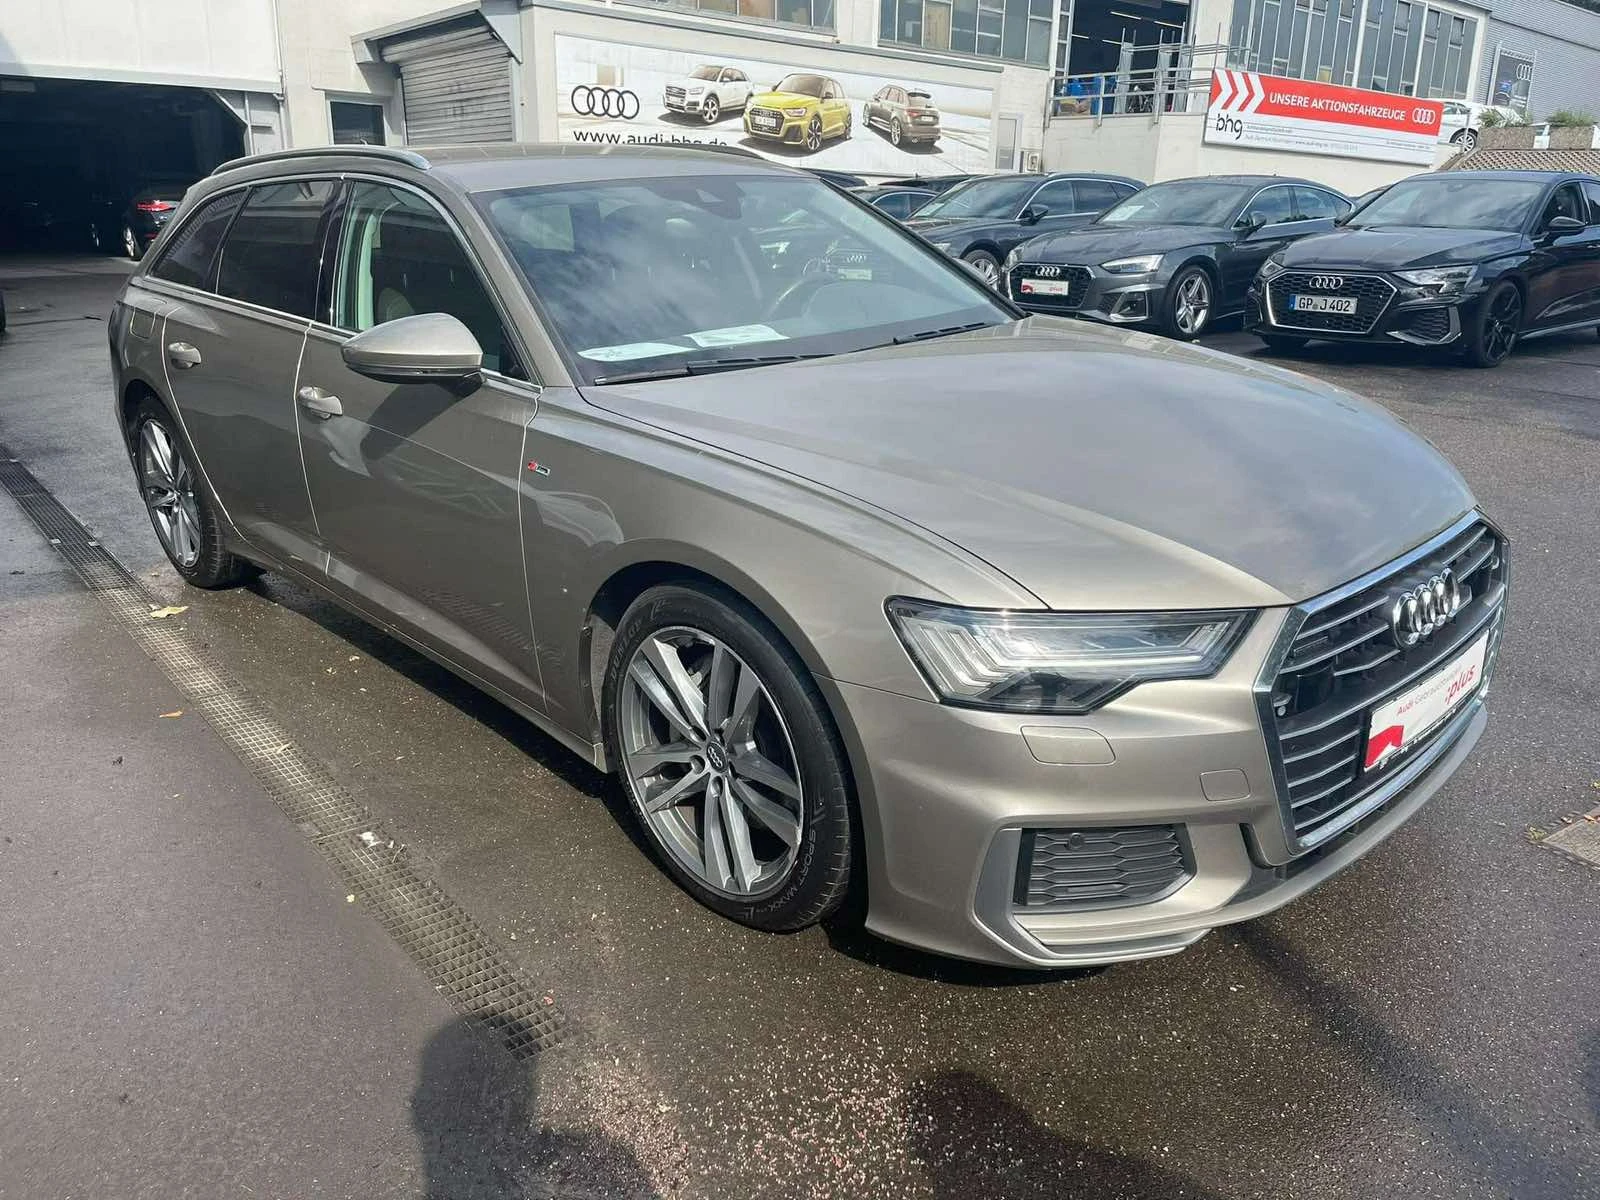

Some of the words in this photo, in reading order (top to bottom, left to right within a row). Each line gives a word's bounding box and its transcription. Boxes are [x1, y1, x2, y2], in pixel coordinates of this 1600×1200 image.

[1269, 91, 1310, 109] UNSERE
[1311, 96, 1406, 121] AKTIONSFAHRZEUGE
[1215, 113, 1243, 141] bhg
[1298, 297, 1314, 309] GP
[799, 829, 817, 887] SPORT
